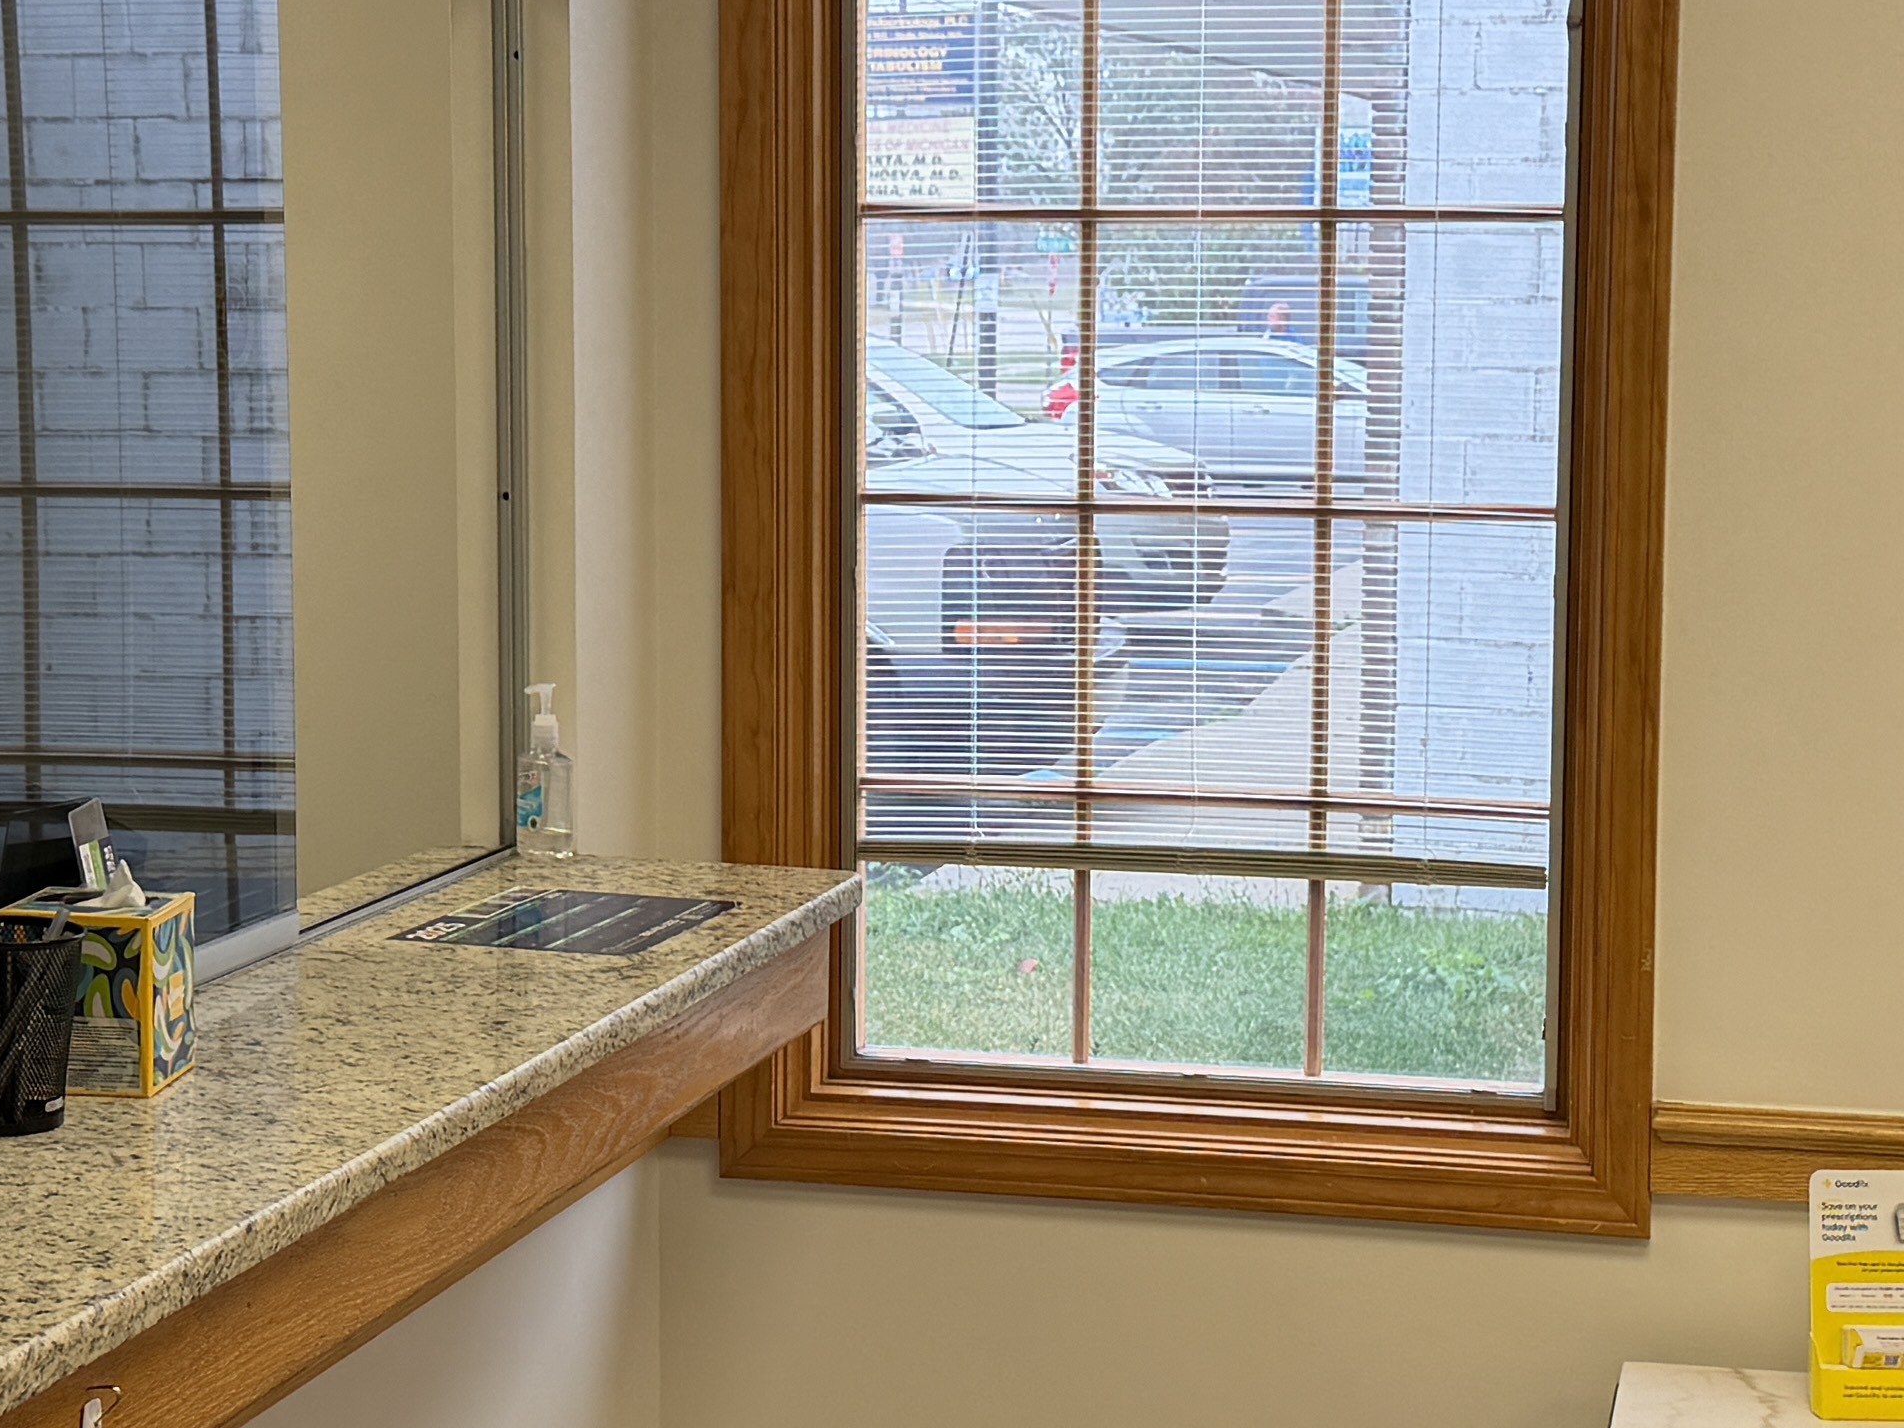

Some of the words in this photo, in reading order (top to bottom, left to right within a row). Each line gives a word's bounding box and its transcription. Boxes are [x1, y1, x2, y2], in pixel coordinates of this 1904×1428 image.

[1834, 1179, 1869, 1189] GoodRx
[1821, 1201, 1843, 1211] Save
[1845, 1203, 1857, 1211] on
[1859, 1203, 1878, 1213] your
[1821, 1212, 1878, 1223] prescriptions
[1821, 1223, 1847, 1233] today
[1850, 1223, 1868, 1232] with
[1821, 1233, 1856, 1242] GoodRx
